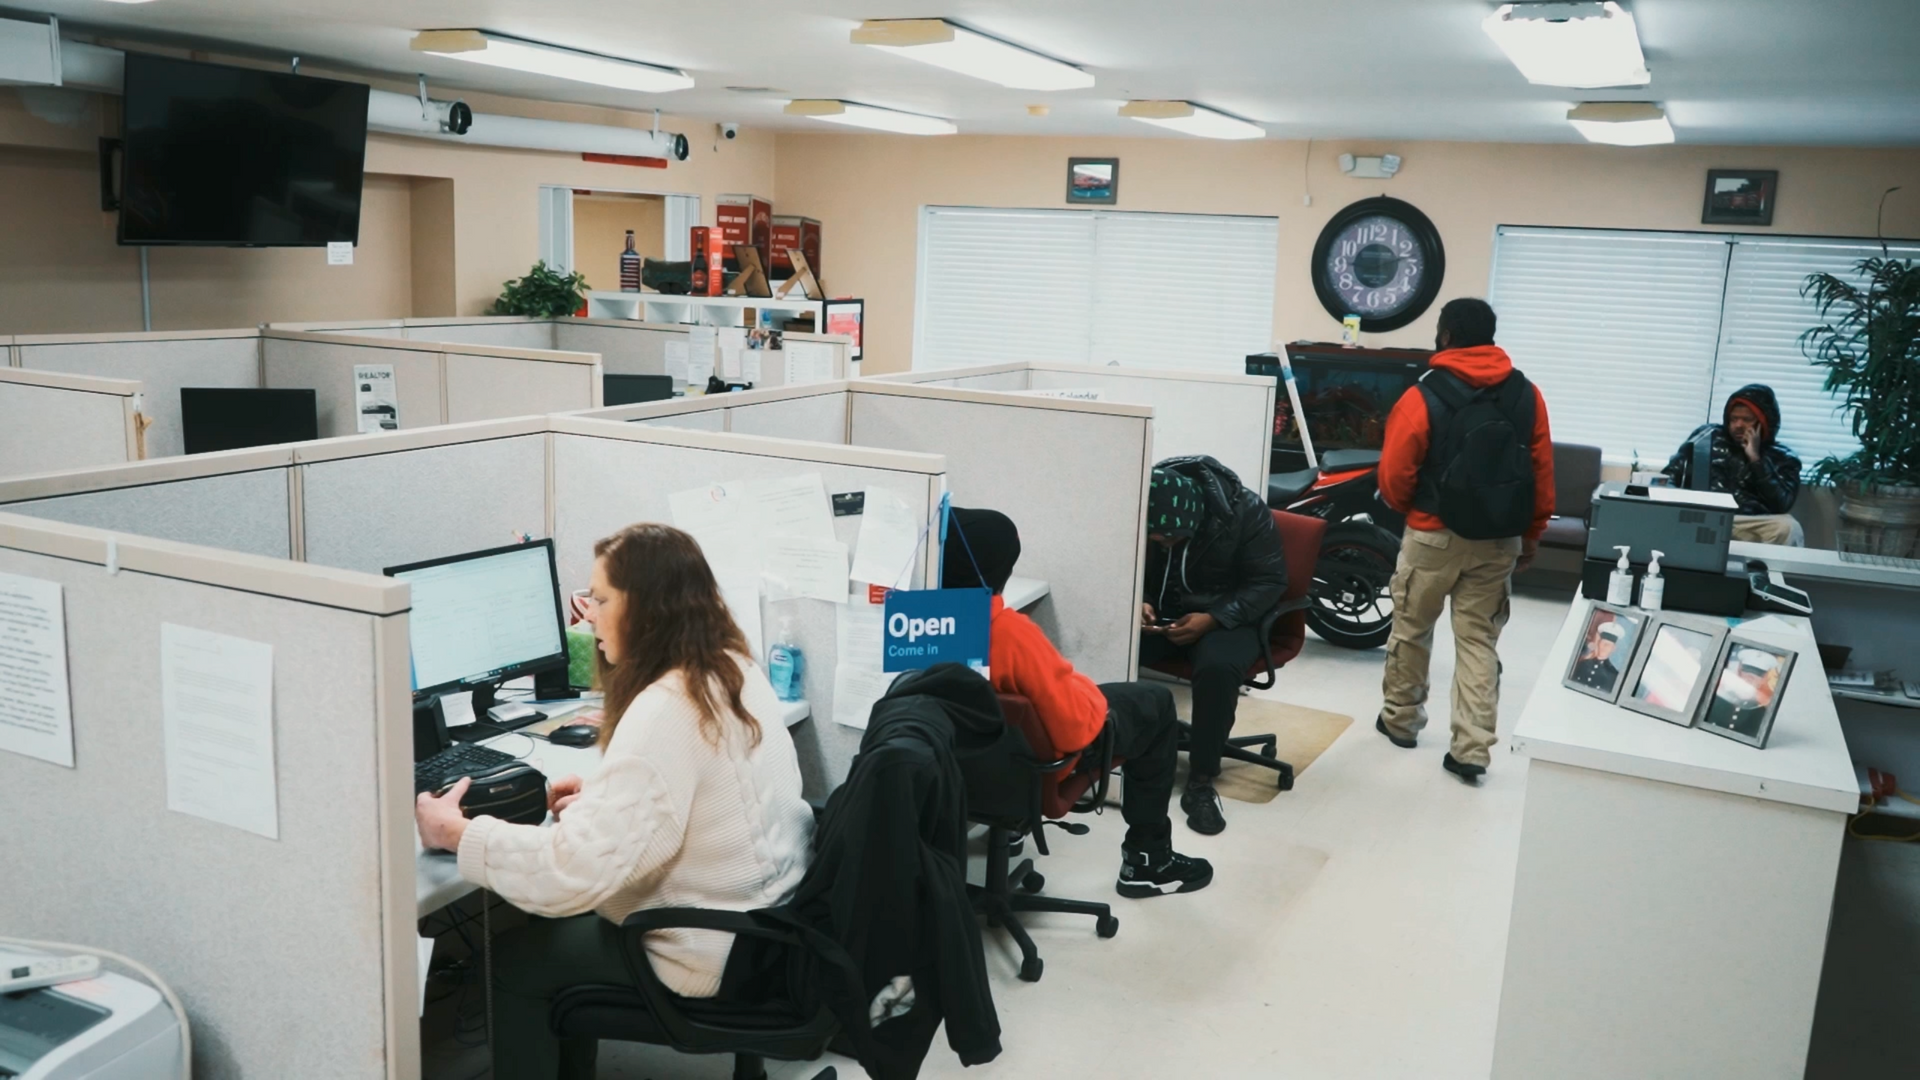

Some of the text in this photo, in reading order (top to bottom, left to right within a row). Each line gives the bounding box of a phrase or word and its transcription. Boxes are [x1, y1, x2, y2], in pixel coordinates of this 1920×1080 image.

[1357, 227, 1368, 244] 11
[1370, 224, 1387, 241] 12
[1392, 229, 1398, 246] 1
[1342, 240, 1357, 257] 10
[1400, 240, 1412, 257] 2
[1334, 256, 1348, 273] 9
[1405, 259, 1417, 276] 3
[1339, 273, 1352, 290] 8
[1402, 276, 1411, 292] 4
[1353, 285, 1364, 302] 7
[1366, 291, 1379, 307] 6
[1384, 287, 1396, 304] 5
[888, 612, 955, 643] Open
[888, 643, 938, 658] Come in
